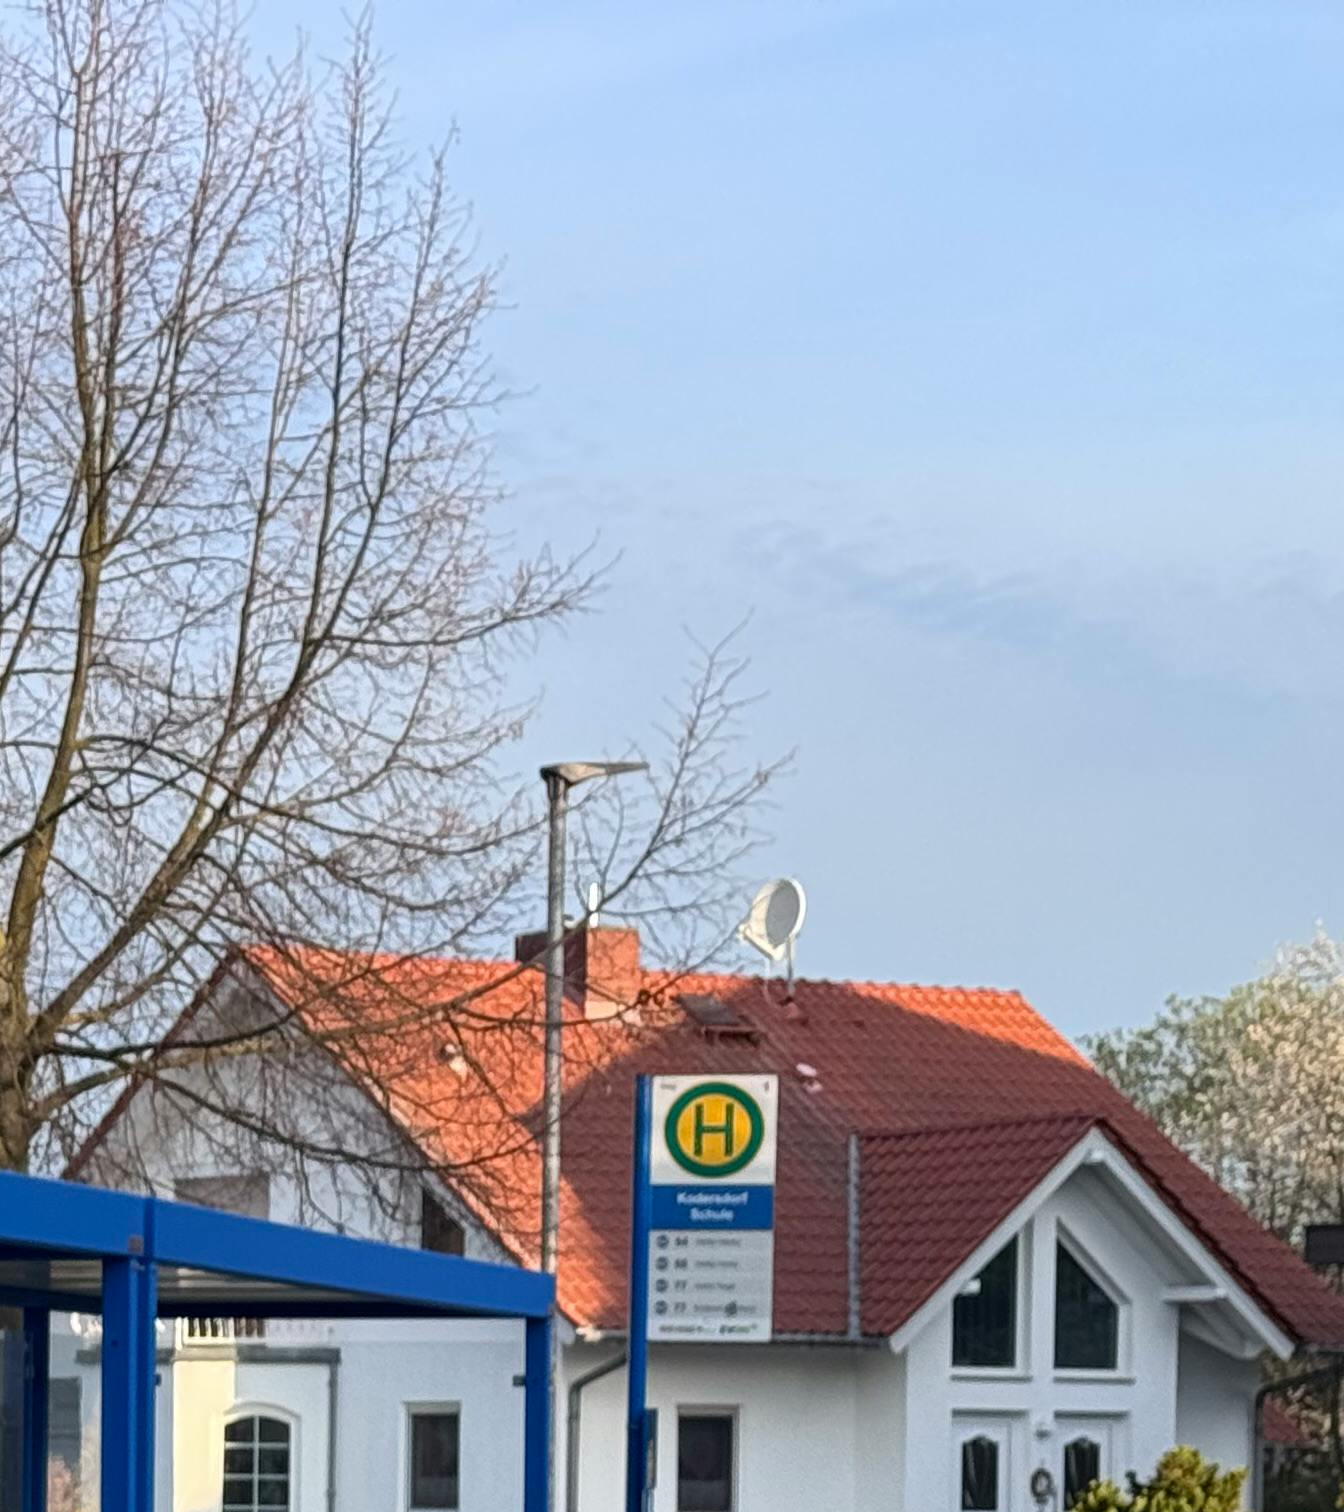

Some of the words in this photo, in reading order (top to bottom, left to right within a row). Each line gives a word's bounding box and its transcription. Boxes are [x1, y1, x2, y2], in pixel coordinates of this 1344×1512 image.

[693, 1102, 735, 1157] H
[676, 1191, 749, 1206] Kodersdorf
[690, 1207, 734, 1221] Schule
